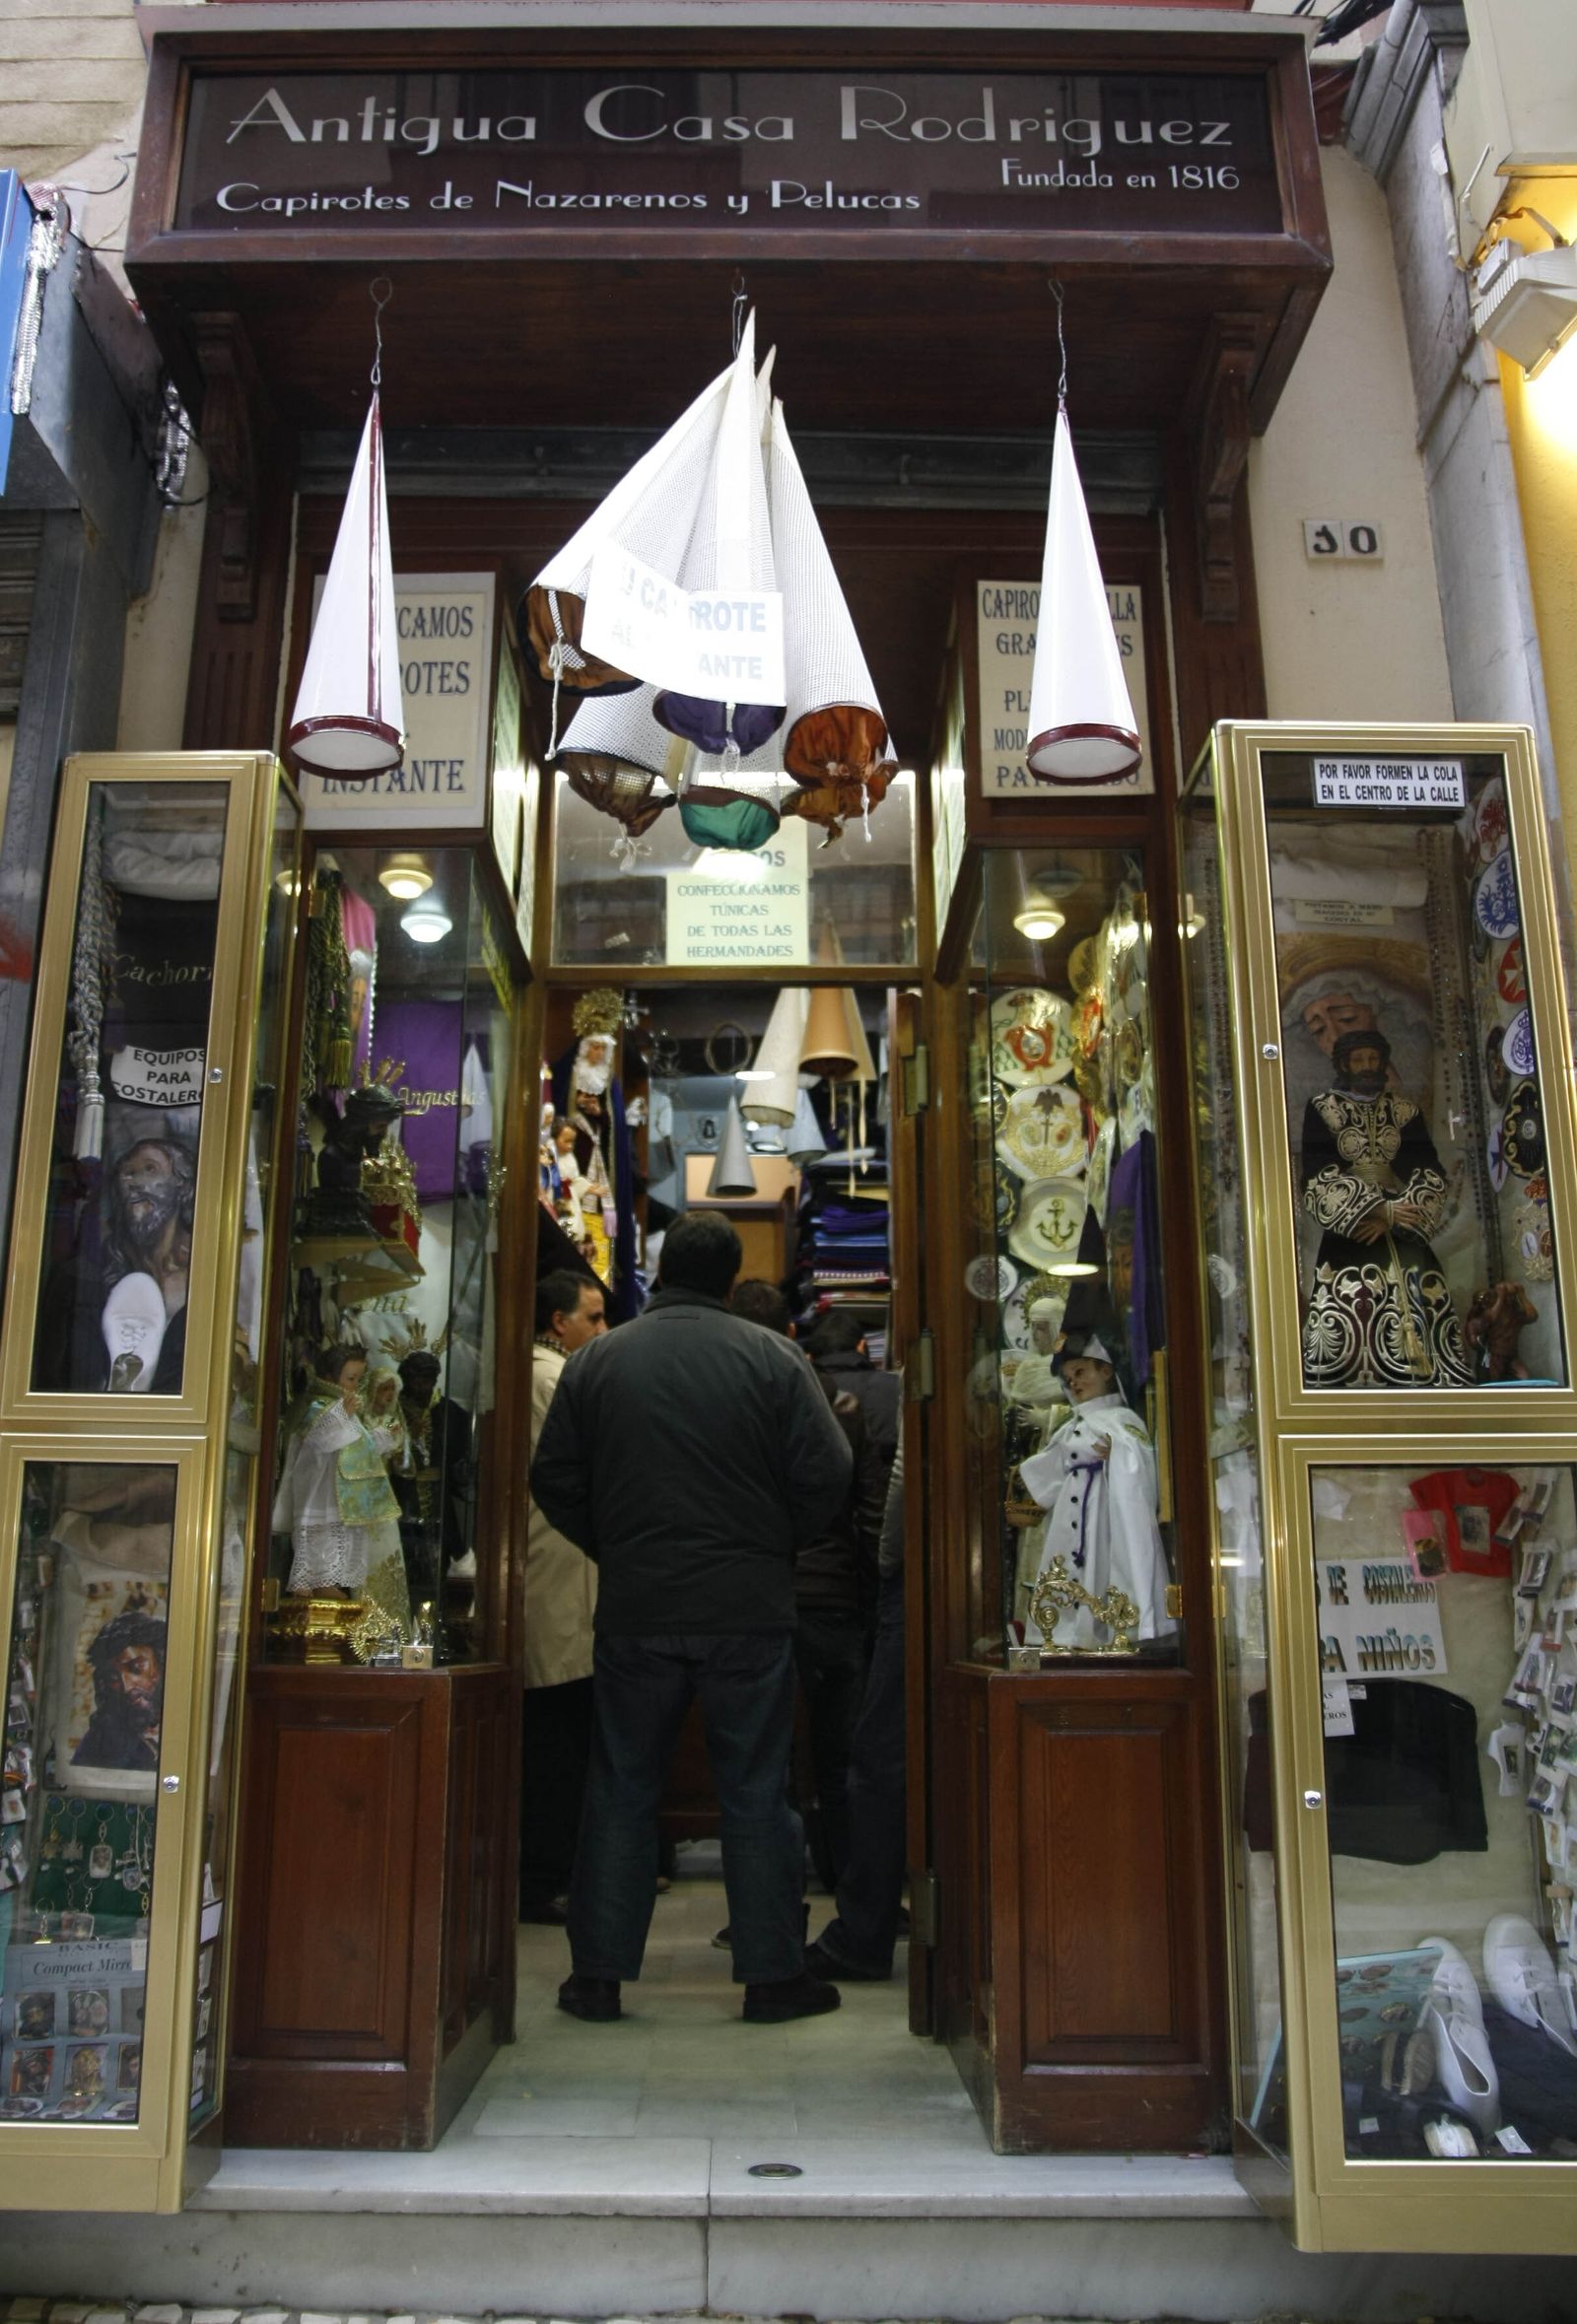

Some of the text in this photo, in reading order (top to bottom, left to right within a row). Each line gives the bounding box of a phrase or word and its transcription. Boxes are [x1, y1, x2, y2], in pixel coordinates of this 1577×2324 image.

[225, 85, 1233, 157] Antigua Casa Rodriguez
[999, 158, 1240, 190] Fundada en 1816
[216, 180, 922, 216] Capirotes de Nazarenos y Pelucas
[983, 588, 1042, 621] CAPIRO
[395, 606, 474, 639] CAMOS
[399, 661, 470, 695] OTES
[1319, 764, 1458, 782] POR FAVOR FORMEN LA COLA
[1321, 785, 1460, 802] EN EL CENTRO DE LA CALLE
[710, 903, 770, 917] TÚNICAS
[687, 924, 793, 937] DE TODAS LAS
[687, 945, 794, 959] HERMANDADES
[133, 1049, 205, 1066] EQUIPOS
[147, 1070, 191, 1084] PARA
[34, 1961, 94, 1977] Compact
